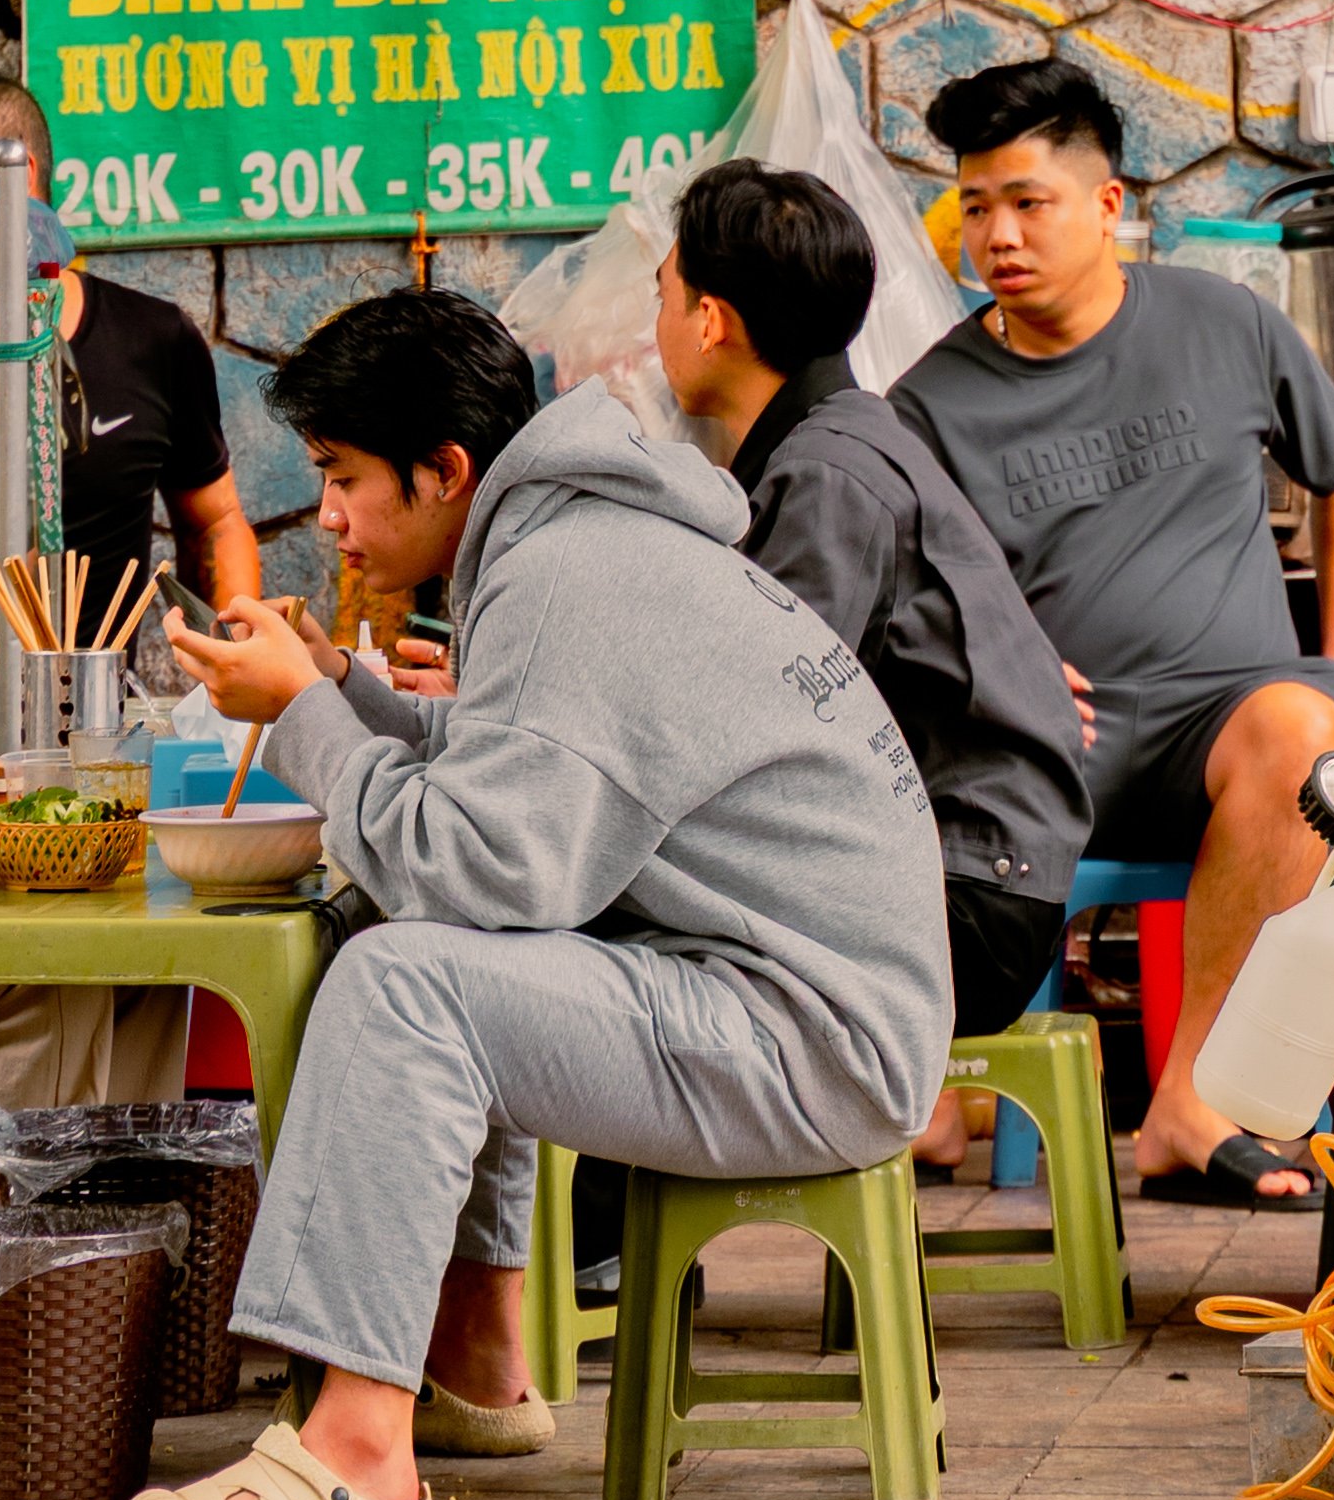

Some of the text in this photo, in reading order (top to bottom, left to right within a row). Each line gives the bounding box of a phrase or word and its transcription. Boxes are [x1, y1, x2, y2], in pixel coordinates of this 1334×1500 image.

[57, 13, 725, 118] HƯƠNG VỊ HÀ NỘI XƯA
[54, 152, 182, 228] 20K
[239, 144, 368, 222] 30K
[426, 136, 555, 214] 35K
